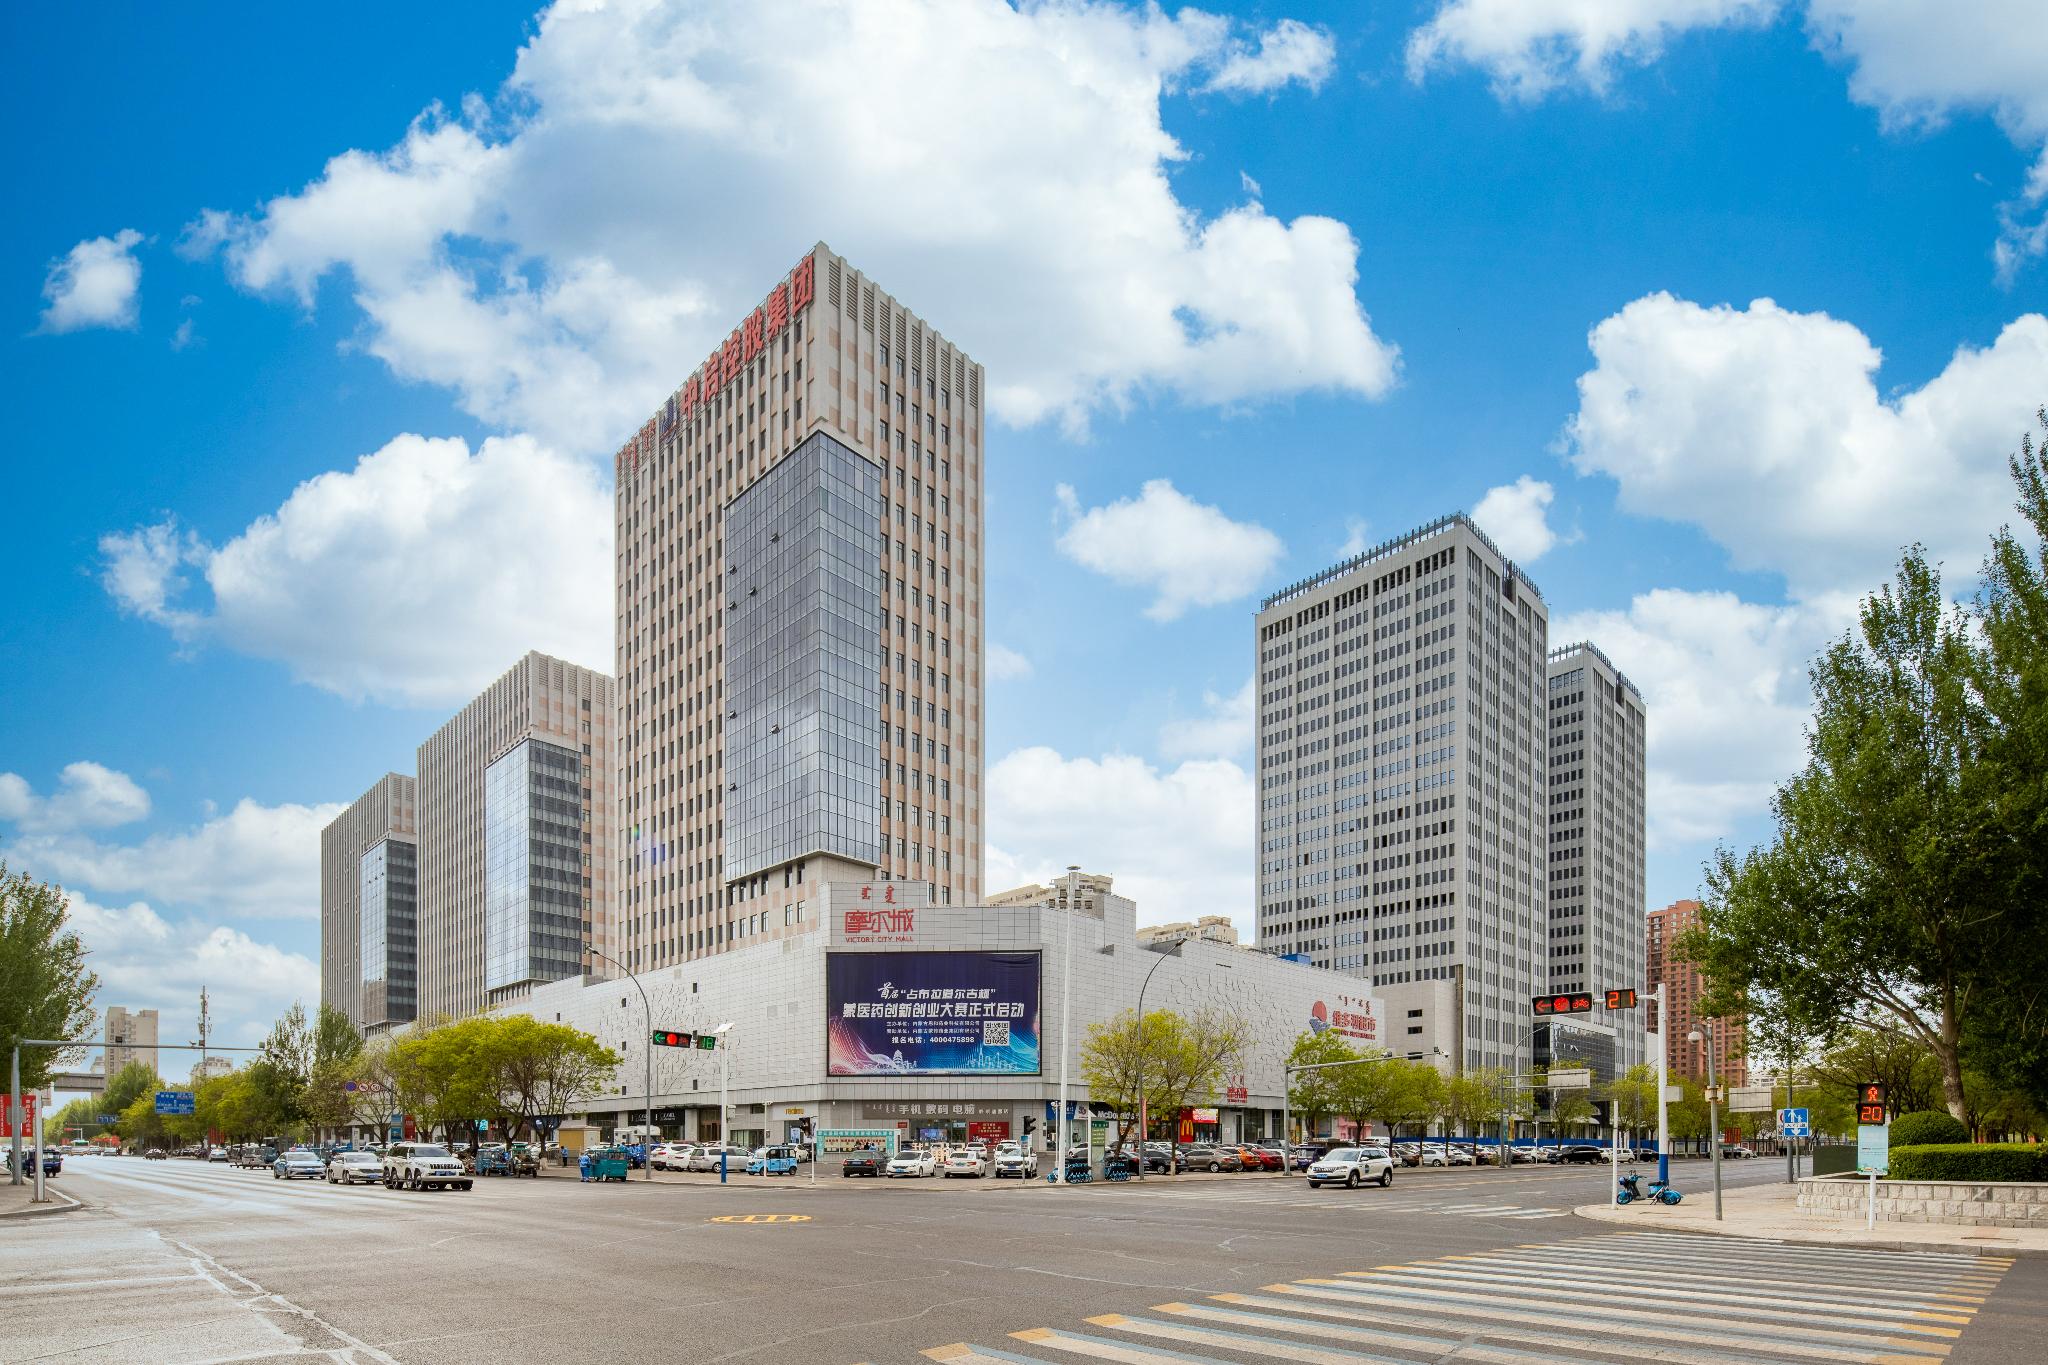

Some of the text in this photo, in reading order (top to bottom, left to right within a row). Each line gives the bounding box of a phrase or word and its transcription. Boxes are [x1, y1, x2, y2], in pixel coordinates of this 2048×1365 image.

[681, 255, 814, 421] 中启控股集团
[845, 909, 913, 933] 摩尔城
[1607, 990, 1635, 1010] 21
[1098, 1111, 1135, 1120] McDoald's
[1861, 1106, 1882, 1121] 20
